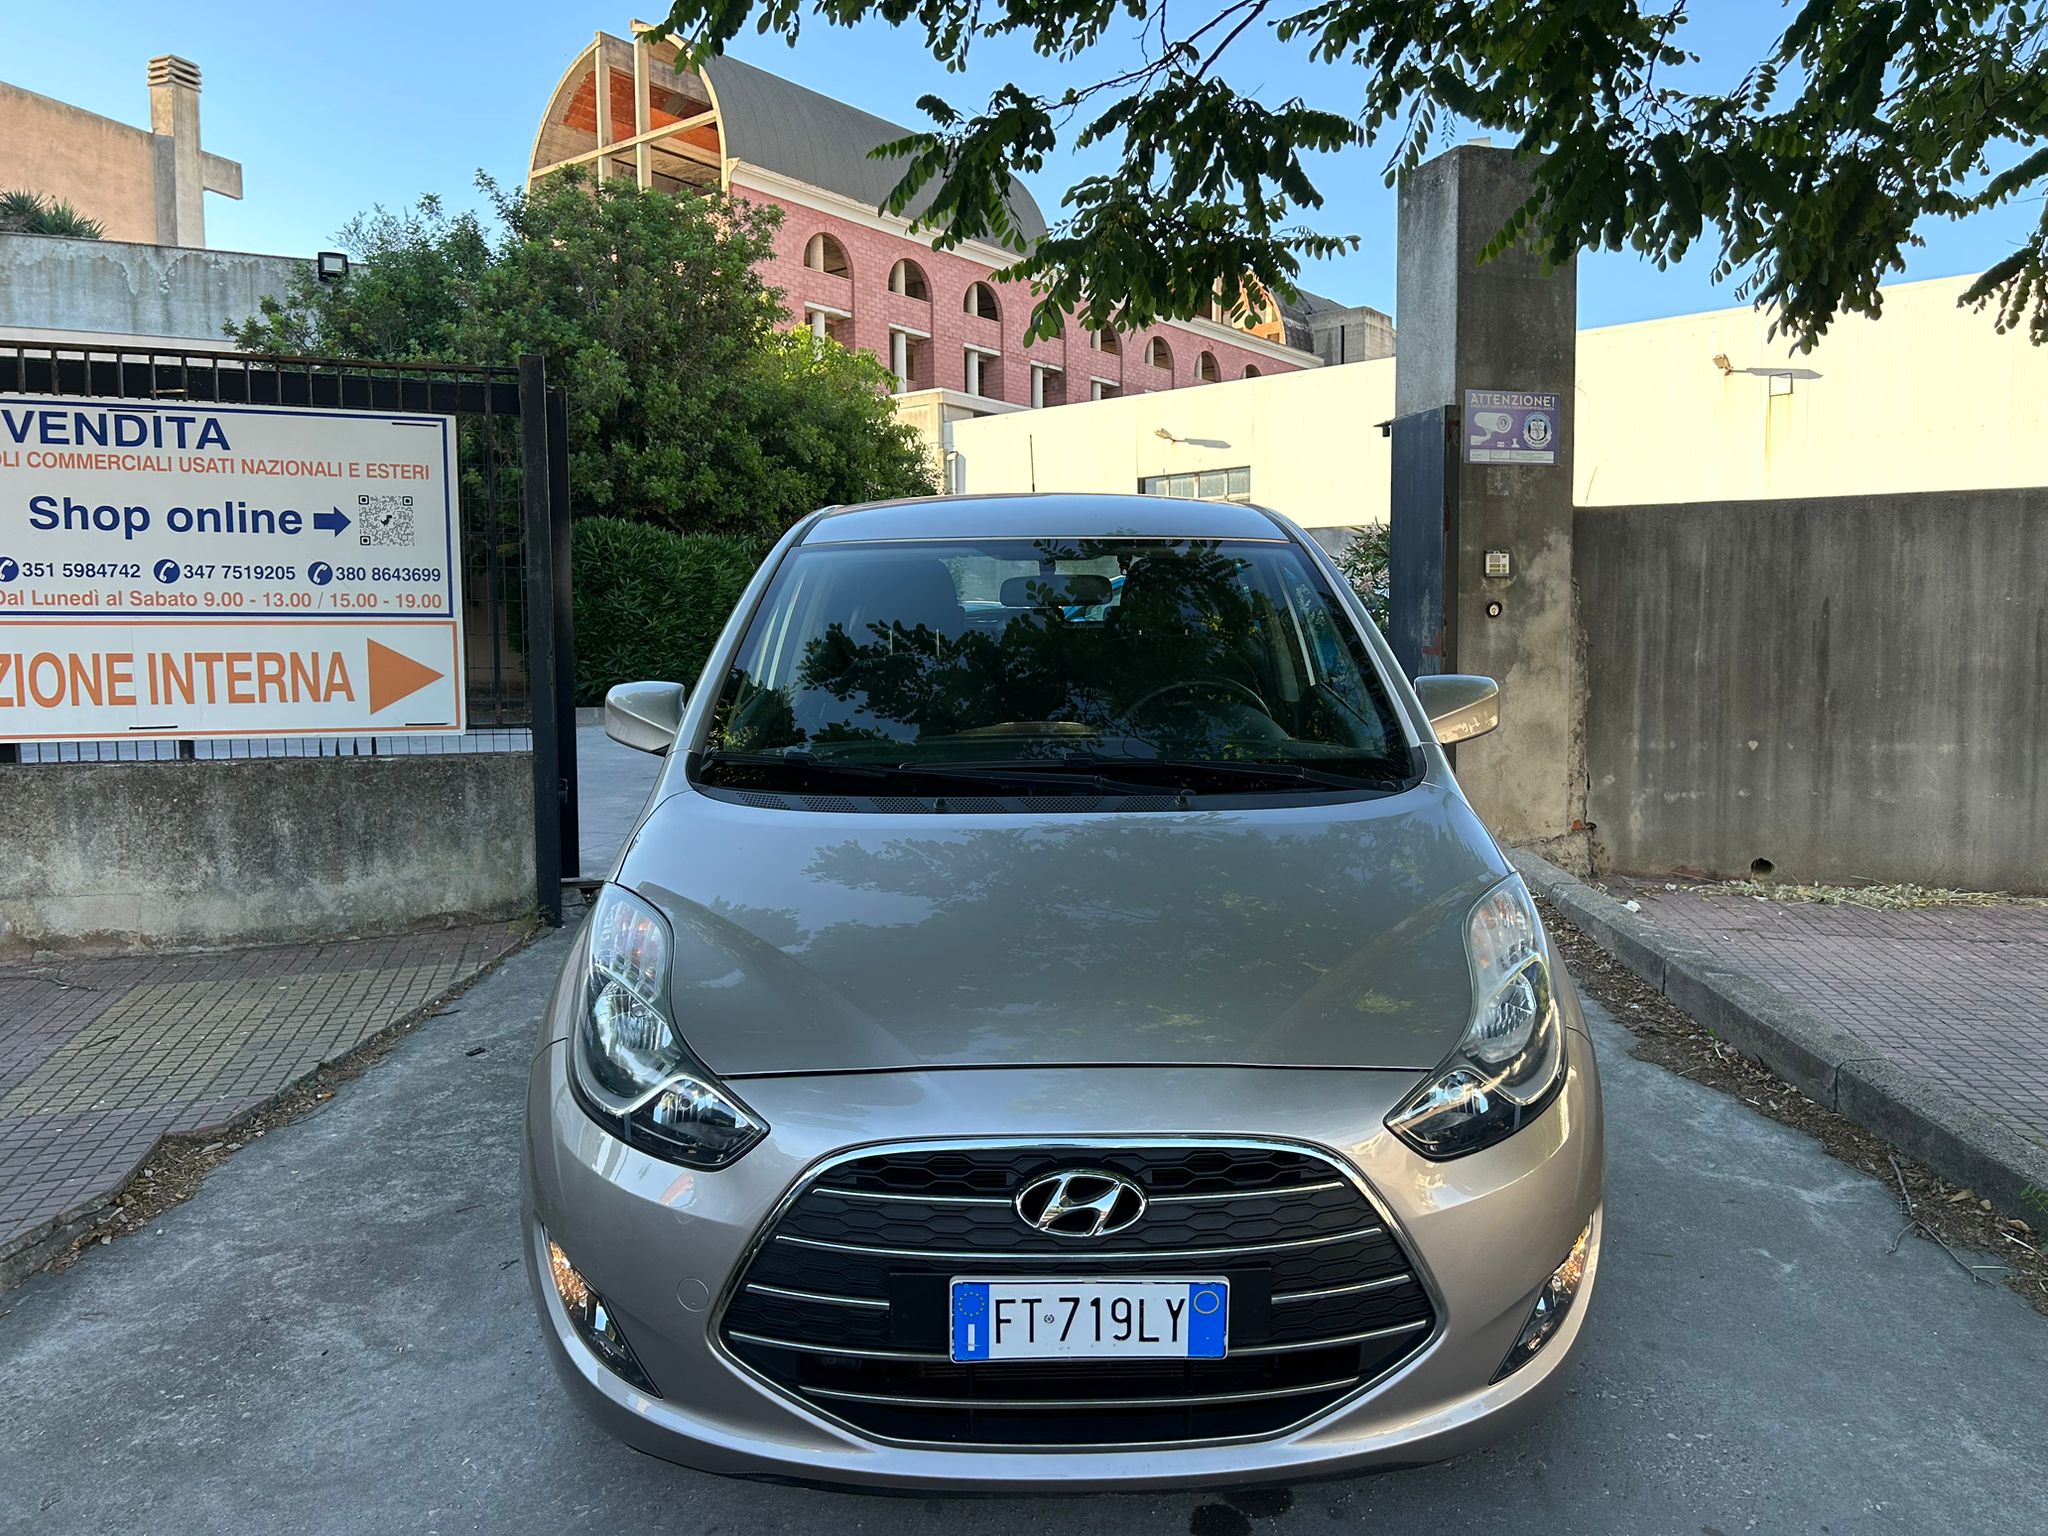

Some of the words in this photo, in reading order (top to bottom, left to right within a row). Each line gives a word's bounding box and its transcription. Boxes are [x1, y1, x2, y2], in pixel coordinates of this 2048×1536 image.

[1470, 393, 1555, 407] ATTENZIONE!
[0, 409, 231, 451] VENDITA
[0, 450, 20, 468] LI
[26, 451, 173, 473] COMMERCIALI
[178, 456, 236, 475] USATI
[241, 459, 342, 479] NAZIONALI
[348, 462, 360, 479] E
[366, 463, 430, 480] ESTERI
[28, 495, 151, 540] Shop
[166, 500, 303, 535] online
[22, 563, 54, 577] 351
[62, 563, 141, 578] 5984742
[183, 564, 216, 579] 347
[221, 565, 296, 581] 7519205
[335, 567, 366, 582] 380
[371, 567, 441, 582] 8643699
[32, 589, 99, 606] Lunedì
[106, 591, 123, 606] al
[129, 591, 198, 608] Sabato
[203, 592, 244, 608] 9.00
[263, 592, 312, 608] 13.00
[330, 593, 377, 608] 15.00
[395, 593, 442, 609] 19.00
[147, 651, 355, 705] INTERNA
